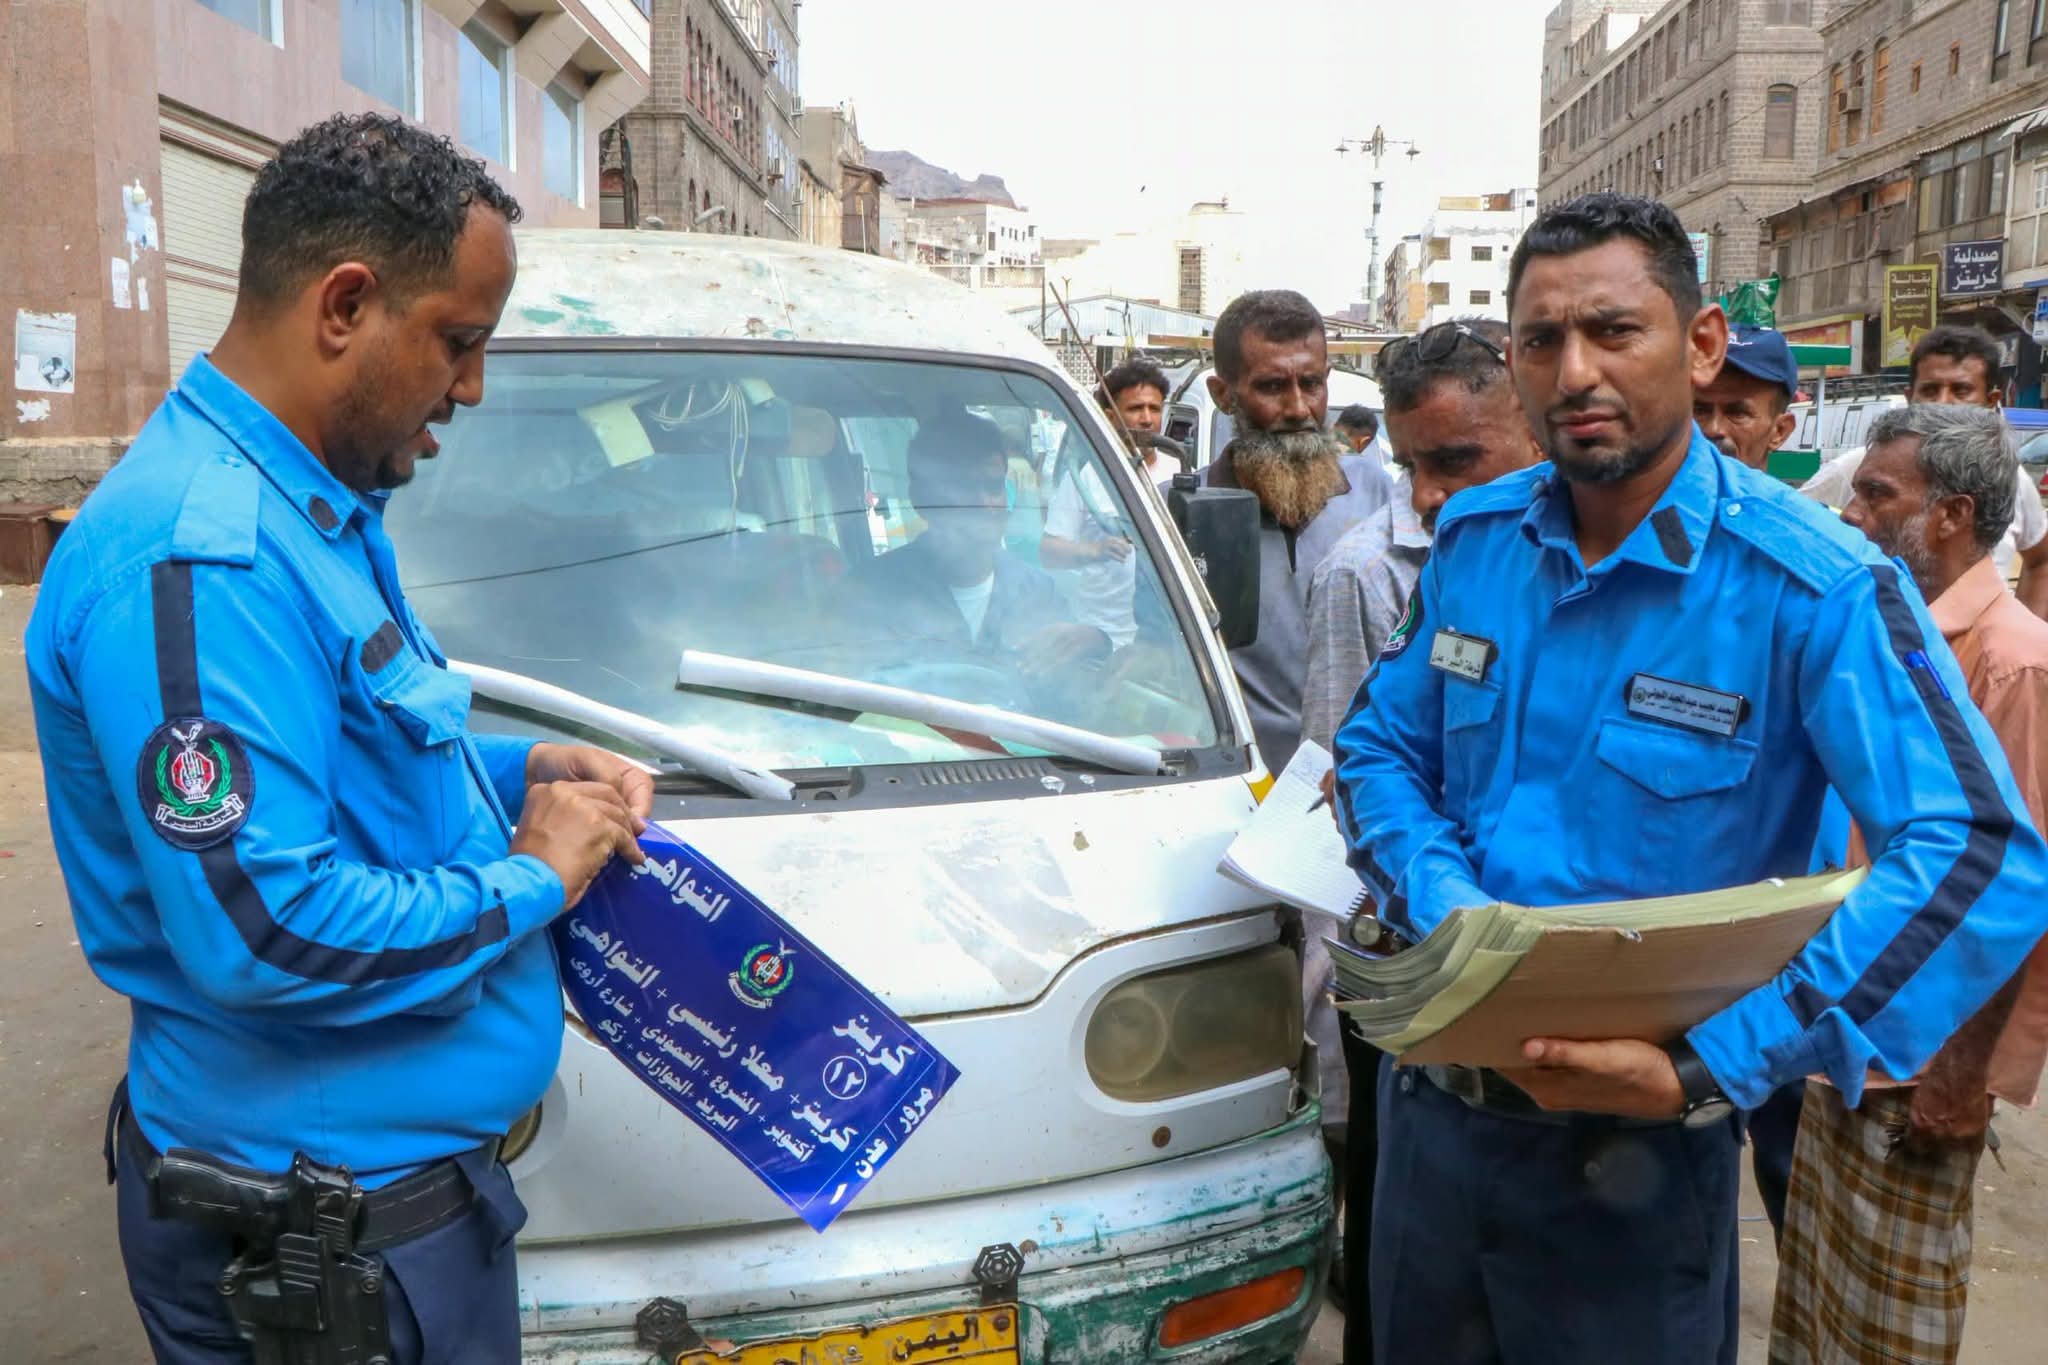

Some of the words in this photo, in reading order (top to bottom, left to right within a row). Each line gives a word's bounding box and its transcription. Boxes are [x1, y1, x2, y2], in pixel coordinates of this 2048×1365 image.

[1952, 266, 1998, 290] كريتر
[1954, 248, 1999, 268] صيدلية
[630, 850, 730, 922] التواهي
[569, 917, 661, 989] التواهي
[599, 988, 635, 1017] شارع
[642, 1027, 704, 1071] العمودي
[667, 1002, 738, 1058] رئيسي
[833, 1015, 915, 1076] كريتر
[637, 1051, 693, 1095] الجوازات
[741, 1045, 784, 1091] معلا
[828, 1060, 863, 1094] ١٢
[696, 1098, 739, 1131] البريد
[710, 1076, 761, 1115] المشروع
[900, 1088, 934, 1133] مرور
[764, 1126, 815, 1162] أكتوبر
[792, 1101, 858, 1152] كريتر
[856, 1139, 888, 1179] عدن
[893, 1317, 979, 1361] اليمن
